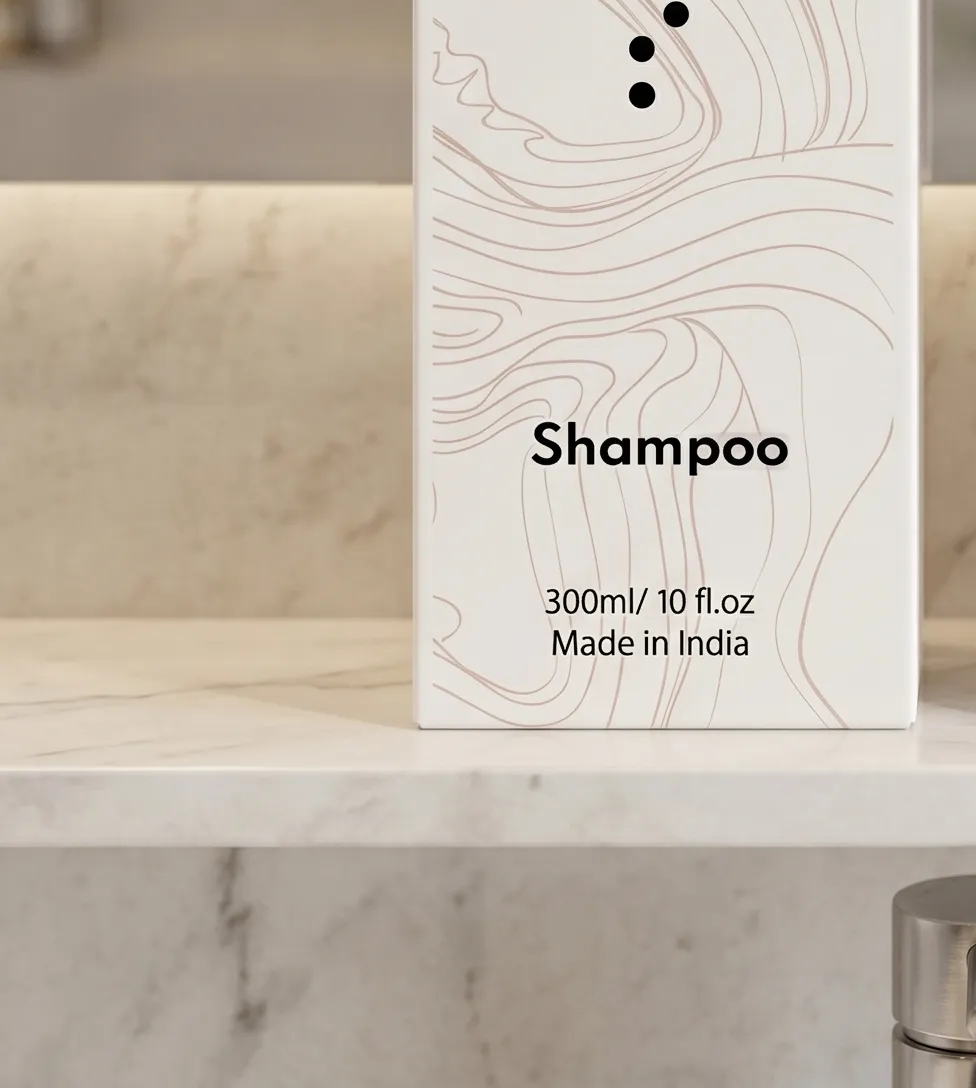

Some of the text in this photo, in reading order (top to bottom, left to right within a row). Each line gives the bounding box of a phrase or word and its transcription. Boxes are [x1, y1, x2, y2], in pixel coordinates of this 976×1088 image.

[531, 421, 789, 477] Shampoo
[544, 586, 755, 616] 300ml/ 10 fl.oz
[552, 628, 749, 657] Made in India
